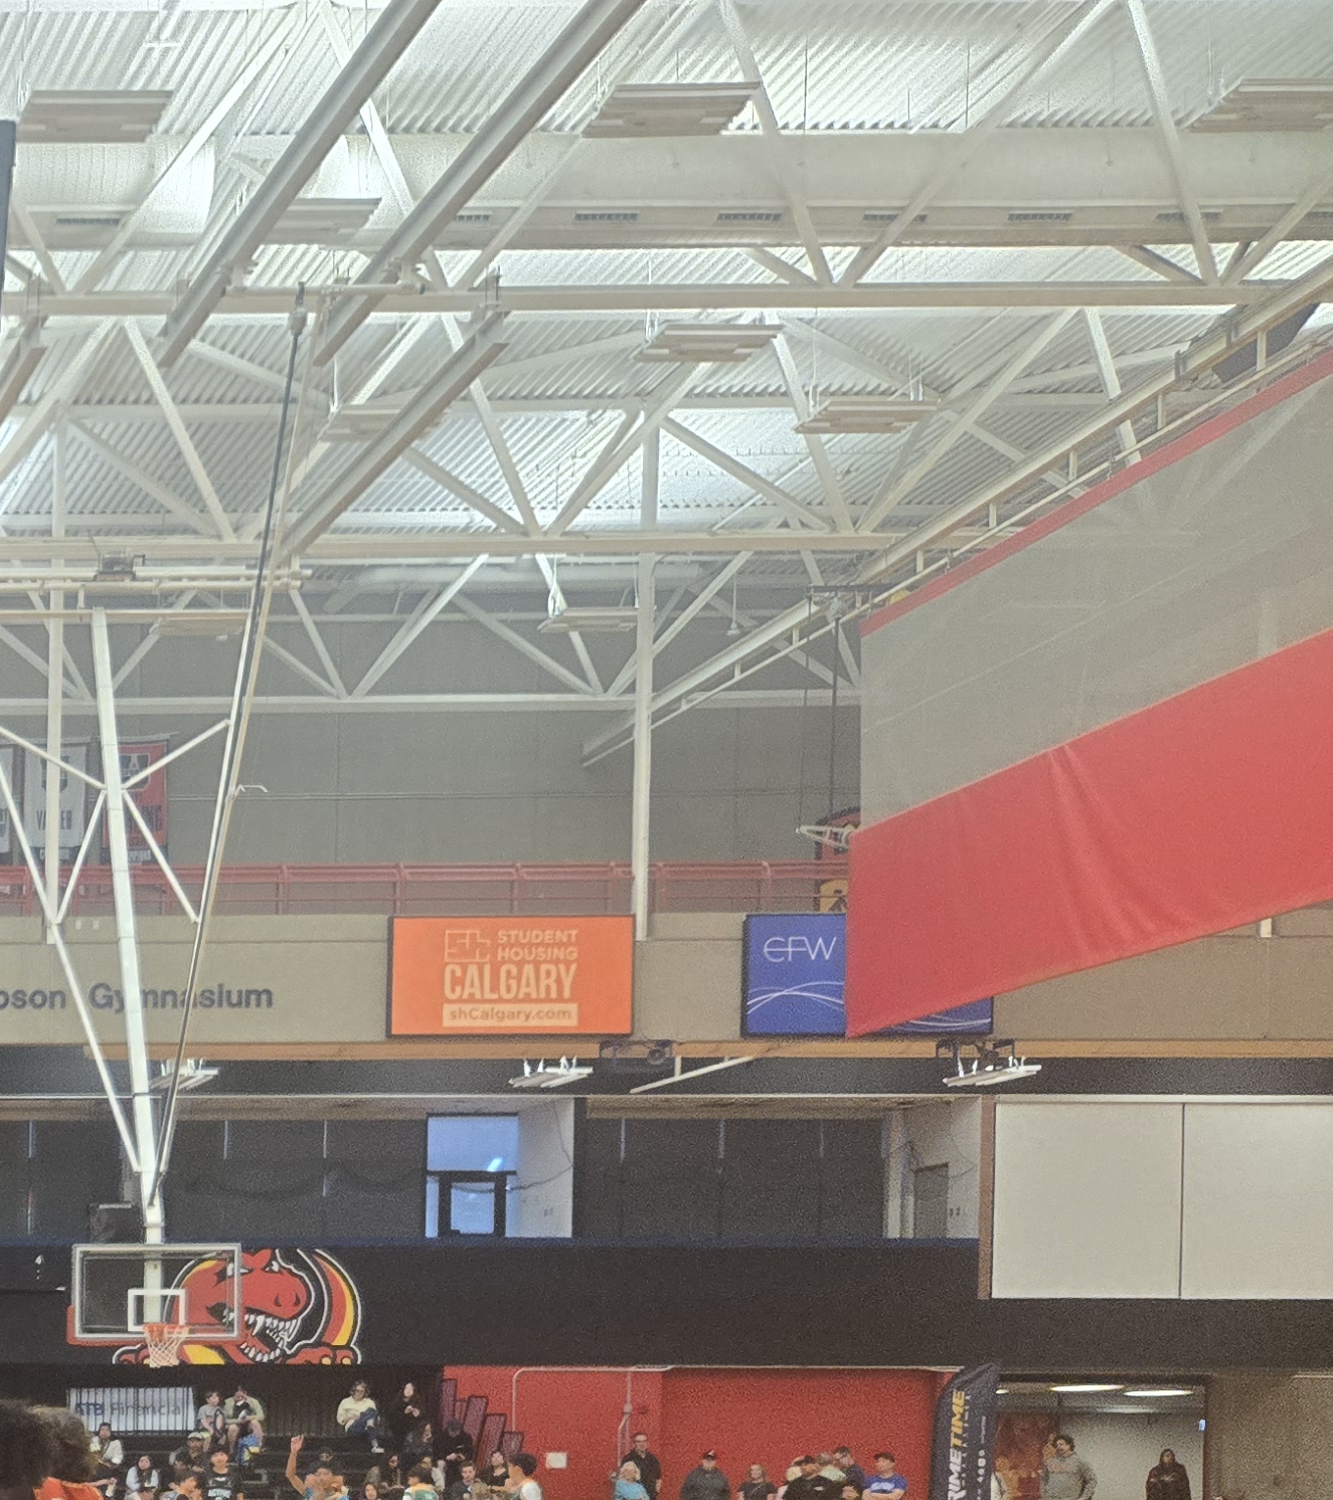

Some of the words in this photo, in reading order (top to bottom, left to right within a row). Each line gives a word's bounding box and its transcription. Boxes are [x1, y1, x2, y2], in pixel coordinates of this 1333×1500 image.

[497, 929, 578, 944] STUDENT
[497, 946, 578, 961] HOUSING
[444, 962, 578, 1000] CALGARY
[449, 1006, 572, 1024] shCalgary.com
